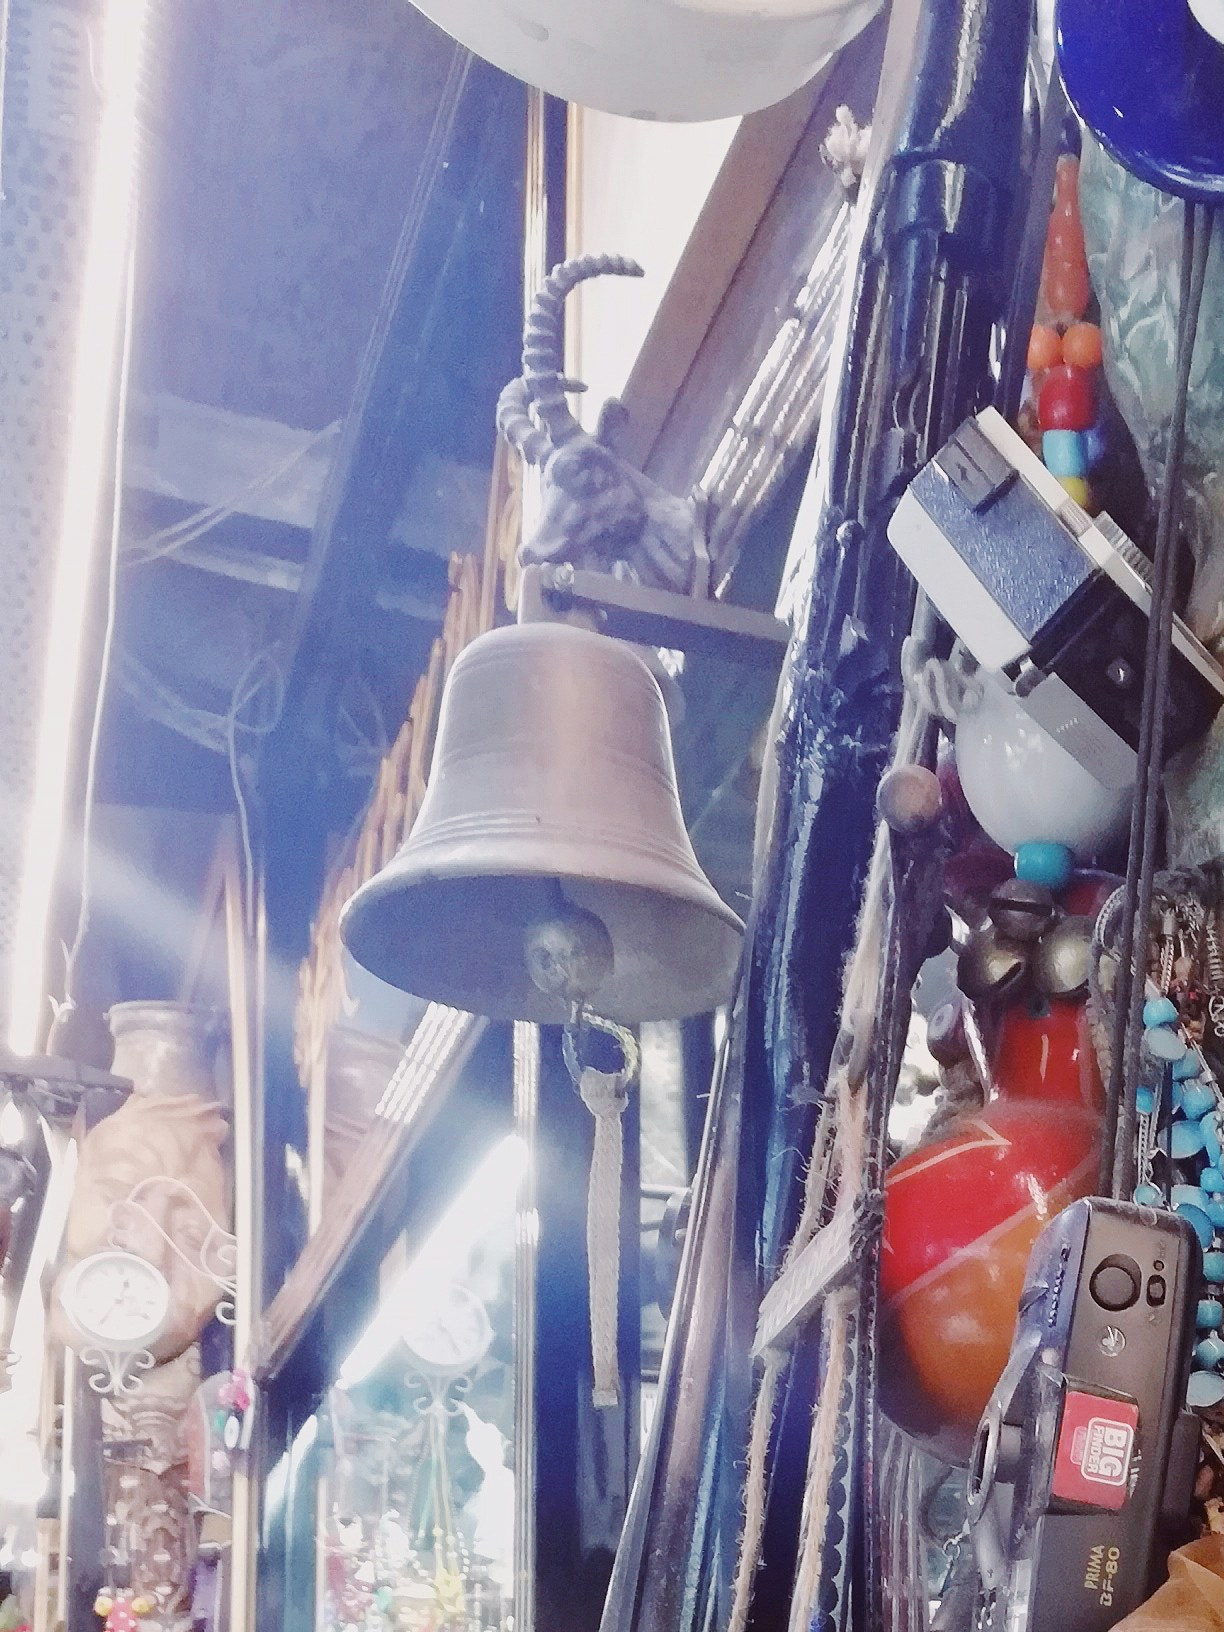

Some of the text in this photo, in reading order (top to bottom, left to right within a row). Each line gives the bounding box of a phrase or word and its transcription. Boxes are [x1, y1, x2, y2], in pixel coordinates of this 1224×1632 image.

[1087, 1425, 1105, 1474] FINDER
[1100, 1426, 1128, 1477] BIG
[1084, 1545, 1105, 1590] PRIMA
[1099, 1547, 1120, 1607] BF-80
